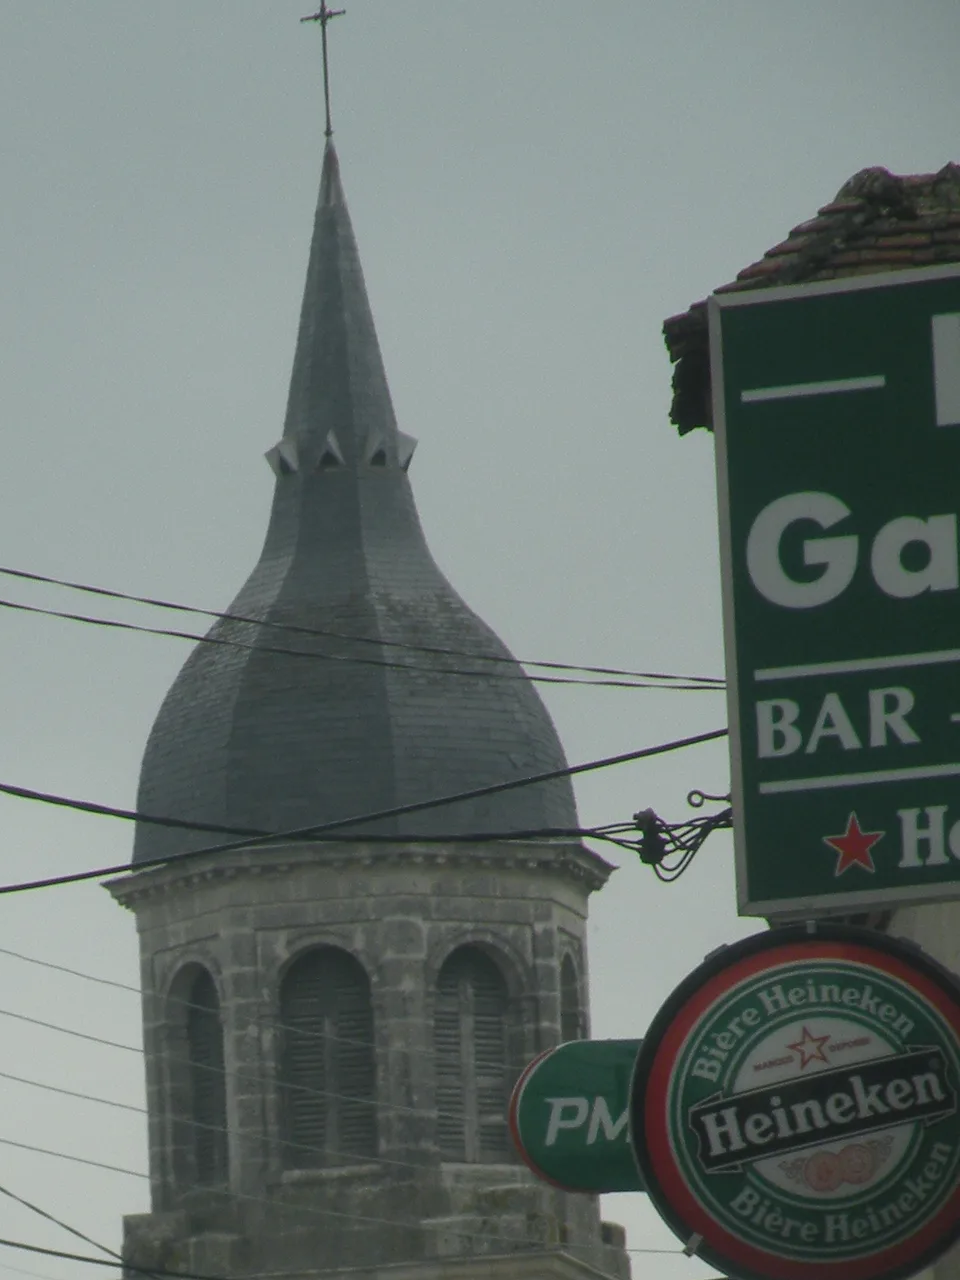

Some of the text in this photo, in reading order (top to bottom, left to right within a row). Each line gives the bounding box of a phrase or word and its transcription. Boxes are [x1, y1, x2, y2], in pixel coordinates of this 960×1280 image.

[746, 490, 959, 608] Ga
[756, 686, 921, 758] BAR
[692, 979, 916, 1083] Bière Heineken
[544, 1096, 632, 1147] PM
[700, 1069, 947, 1158] Heineken
[730, 1142, 952, 1243] Bière Heineken
